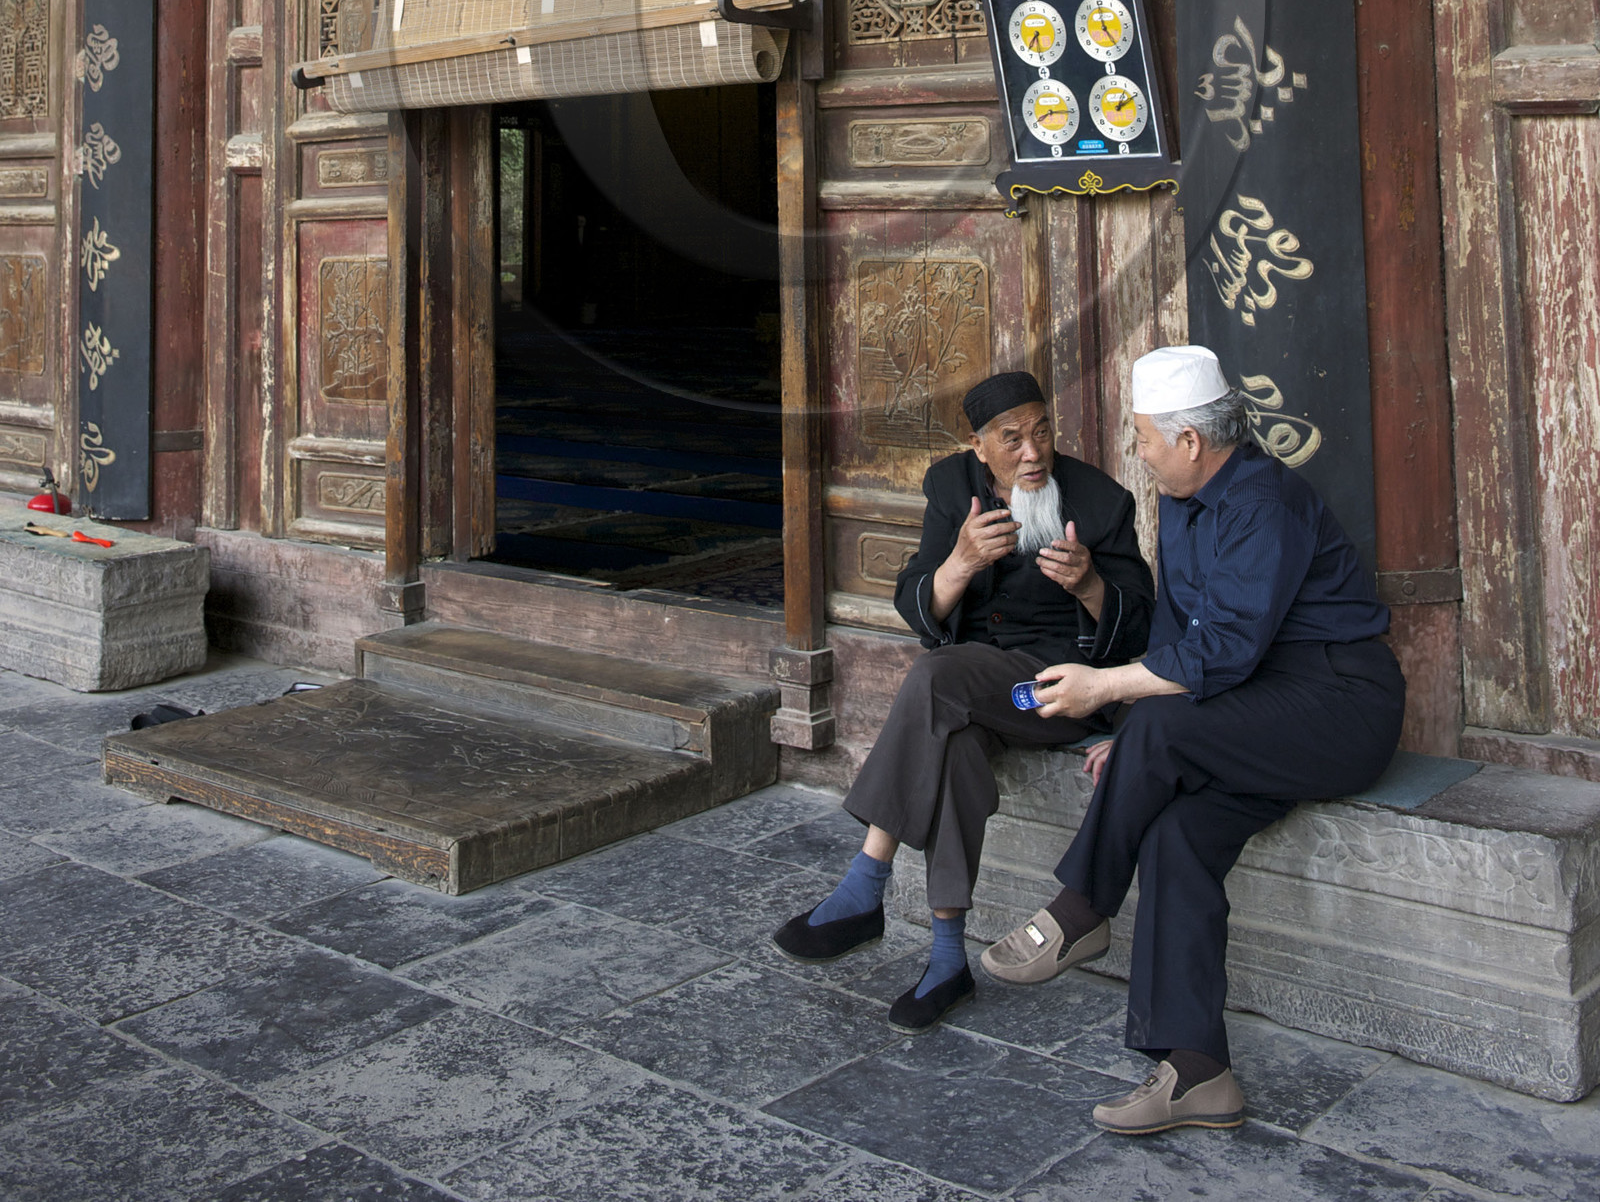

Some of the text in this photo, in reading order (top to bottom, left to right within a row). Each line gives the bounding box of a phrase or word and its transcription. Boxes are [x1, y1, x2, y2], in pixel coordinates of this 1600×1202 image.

[1041, 68, 1047, 77] 4
[1109, 64, 1113, 73] 1
[1054, 147, 1059, 155] 5
[1121, 144, 1127, 154] 2
